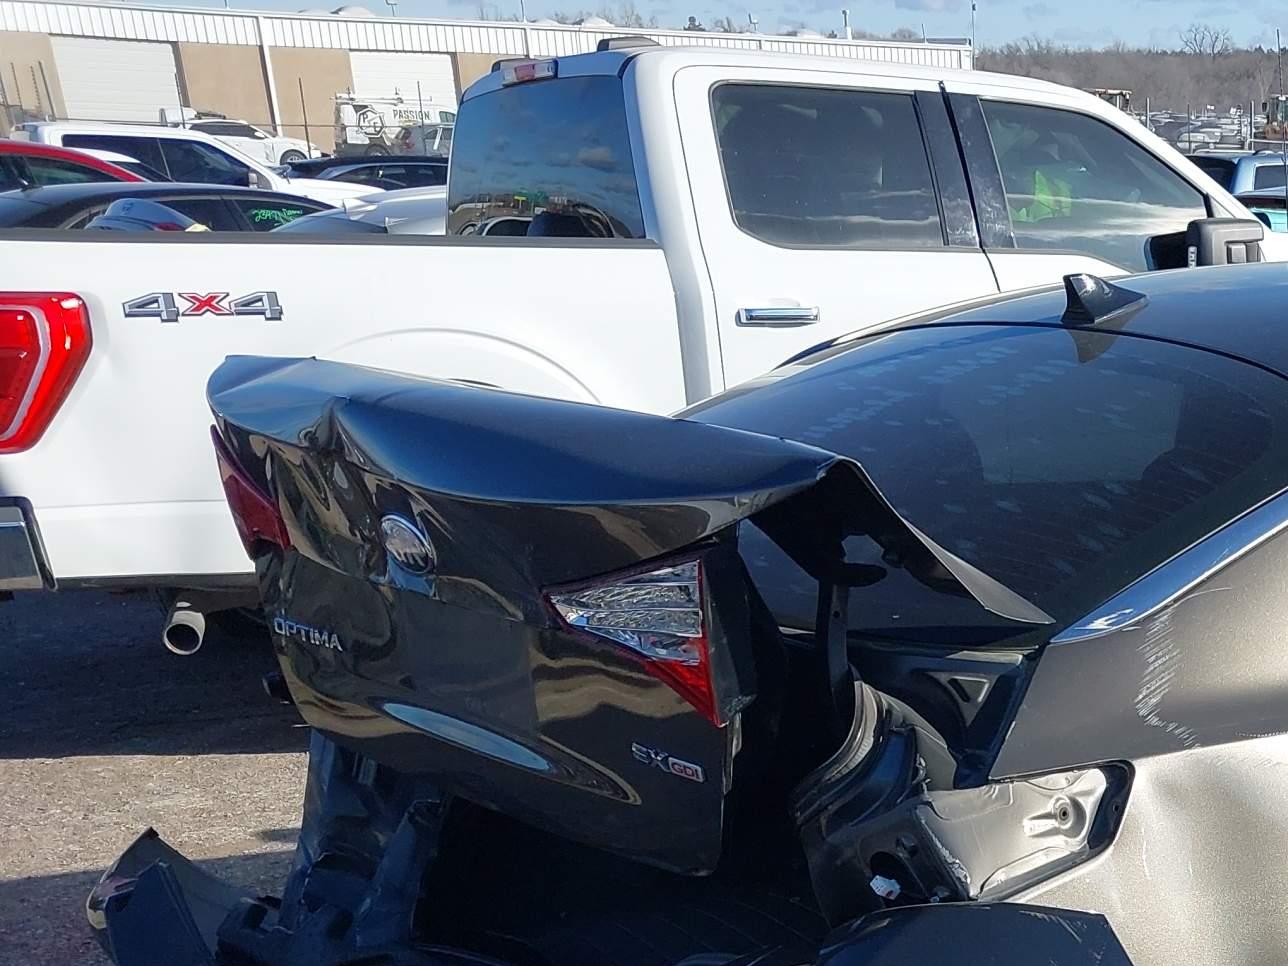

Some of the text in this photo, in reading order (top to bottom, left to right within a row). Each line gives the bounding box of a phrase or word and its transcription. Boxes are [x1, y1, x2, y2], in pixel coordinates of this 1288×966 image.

[393, 109, 431, 121] PASSION
[273, 617, 344, 652] OPTIMA
[631, 741, 672, 773] EX
